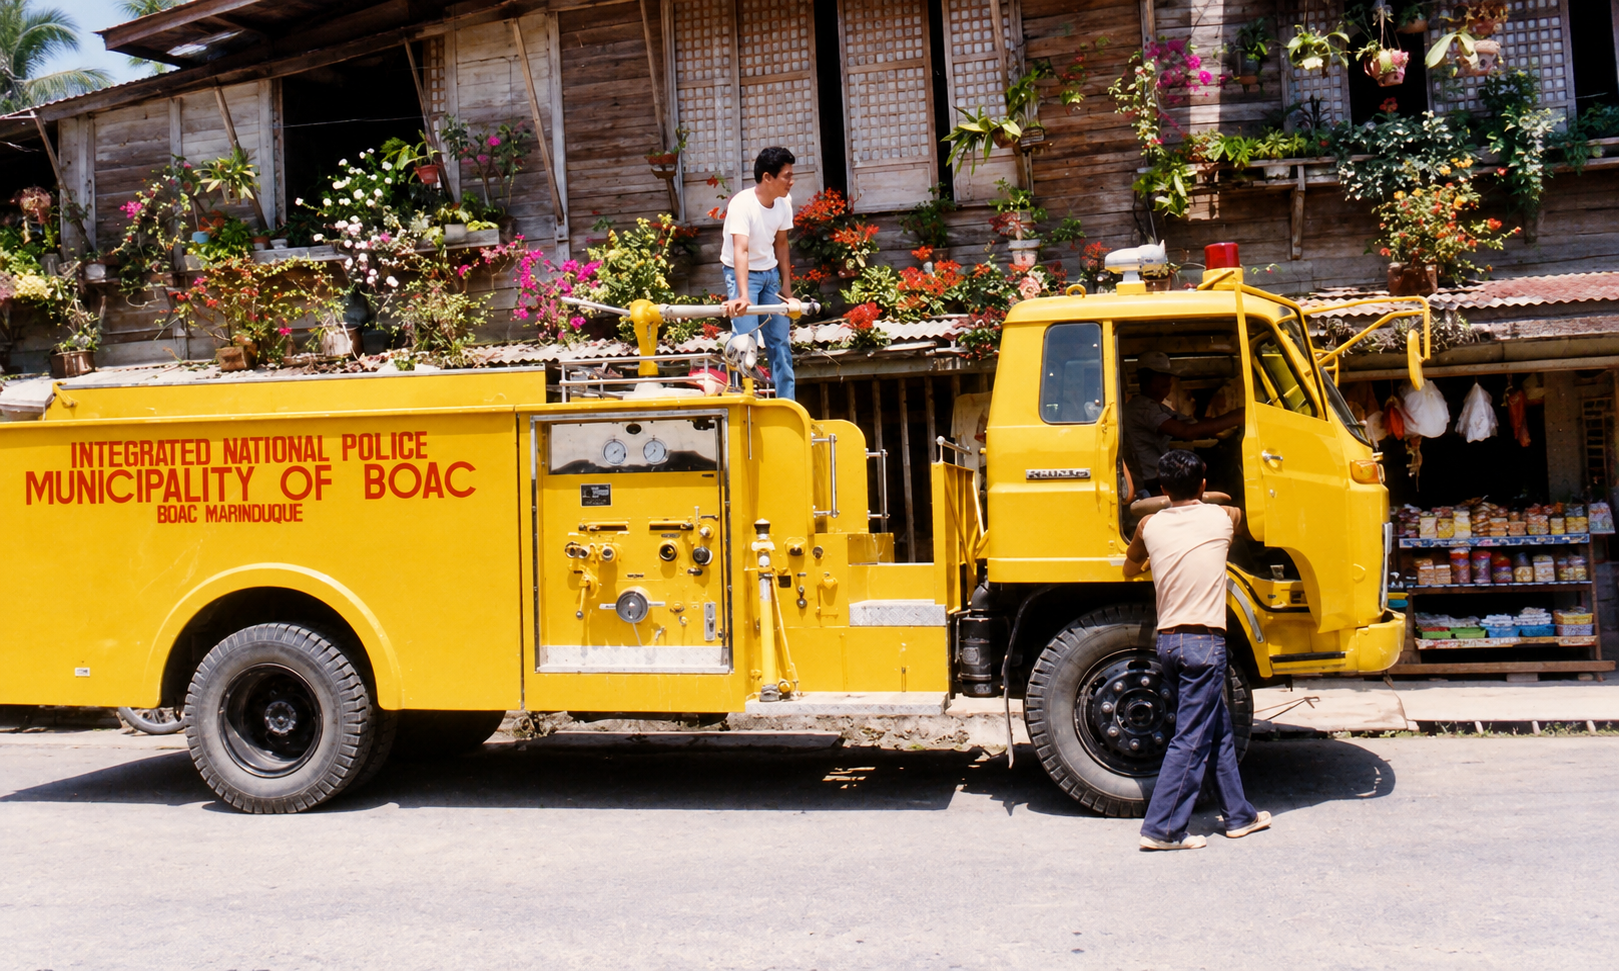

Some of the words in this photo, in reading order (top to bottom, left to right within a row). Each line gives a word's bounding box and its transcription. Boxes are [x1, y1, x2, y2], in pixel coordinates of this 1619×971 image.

[70, 437, 211, 469] INTEGRATED
[222, 434, 330, 465] NATIONAL
[341, 430, 428, 462] POLICE
[25, 465, 256, 506] MUNICIPALITY
[279, 464, 333, 502] OF
[363, 460, 477, 500] BOAC
[156, 503, 198, 524] BOAC
[205, 503, 304, 524] MARINDUQUE
